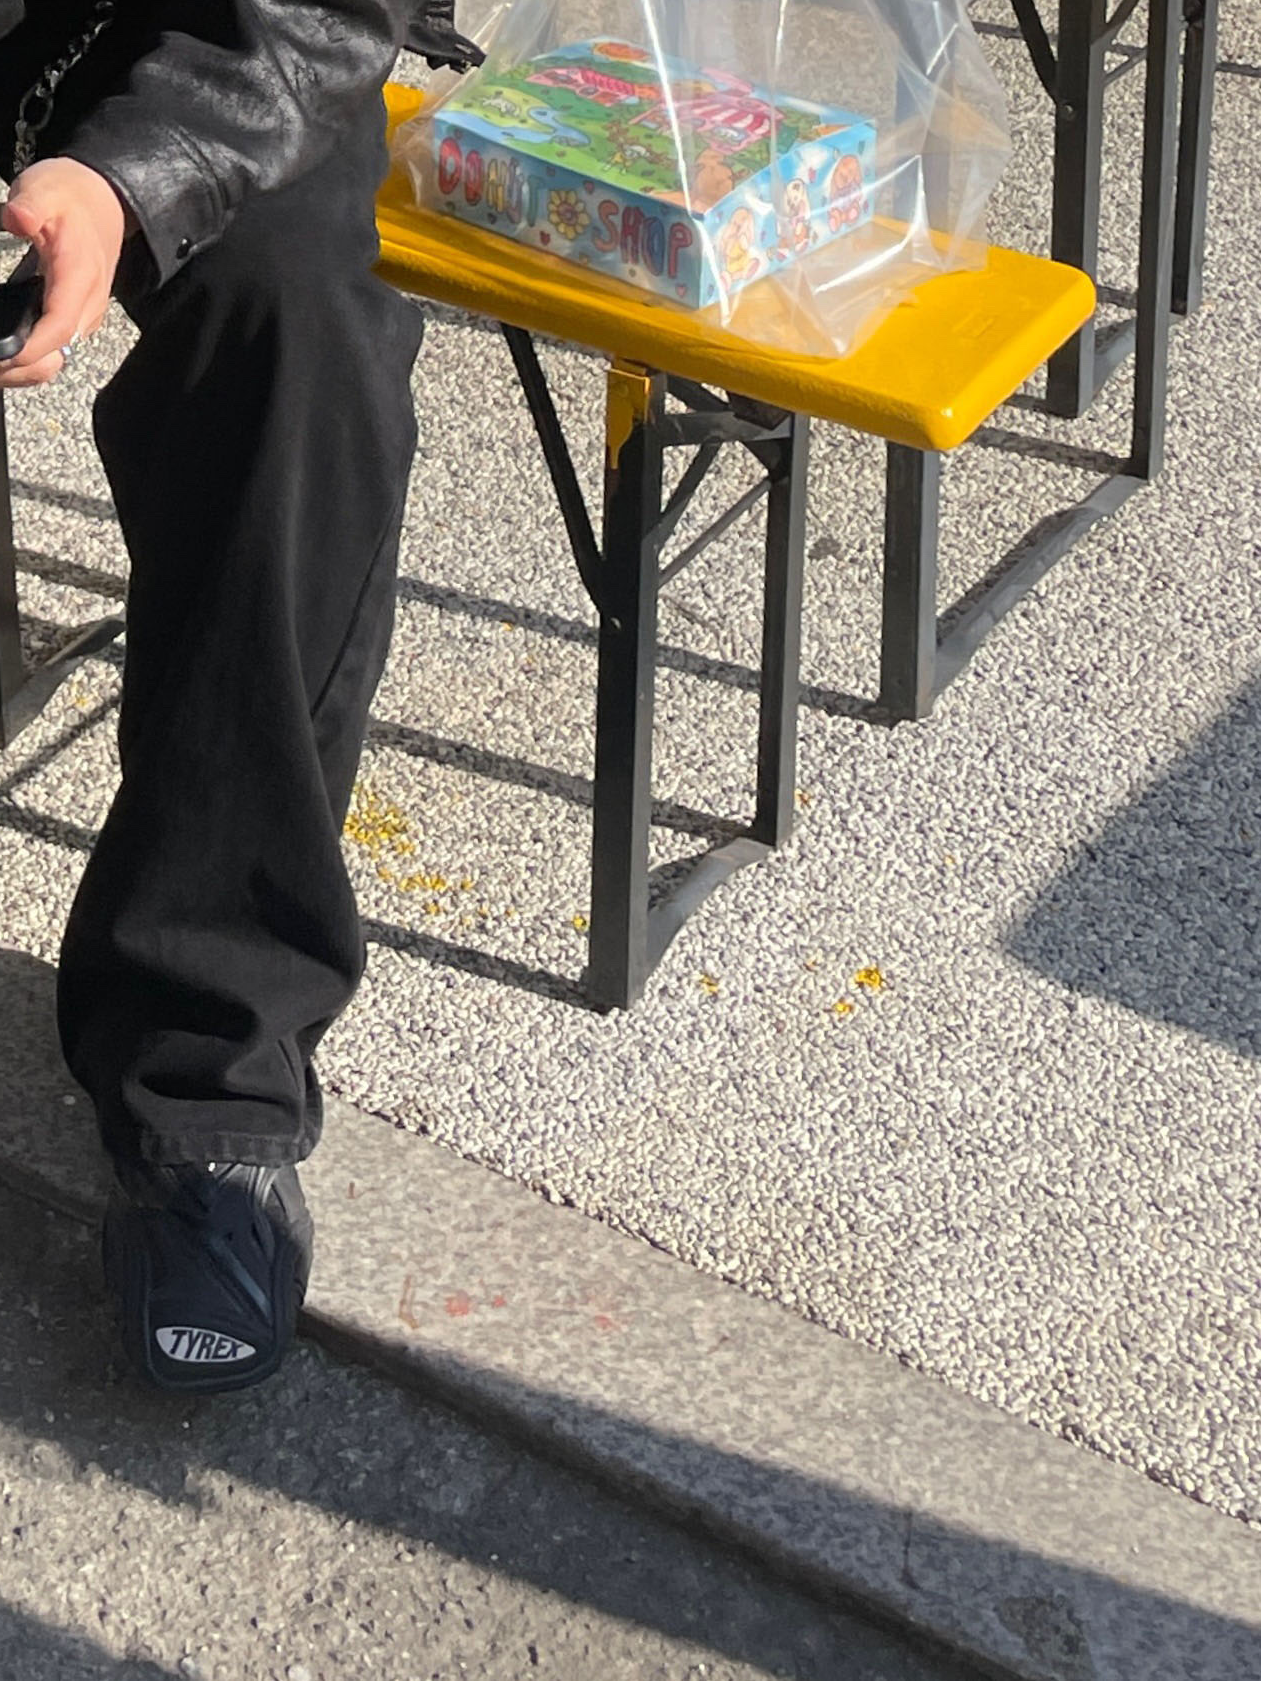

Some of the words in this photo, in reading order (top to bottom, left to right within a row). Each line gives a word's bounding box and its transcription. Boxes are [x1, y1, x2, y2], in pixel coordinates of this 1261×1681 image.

[438, 136, 544, 228] DONUT
[592, 199, 693, 279] SHOP
[169, 1329, 243, 1360] TYREX
